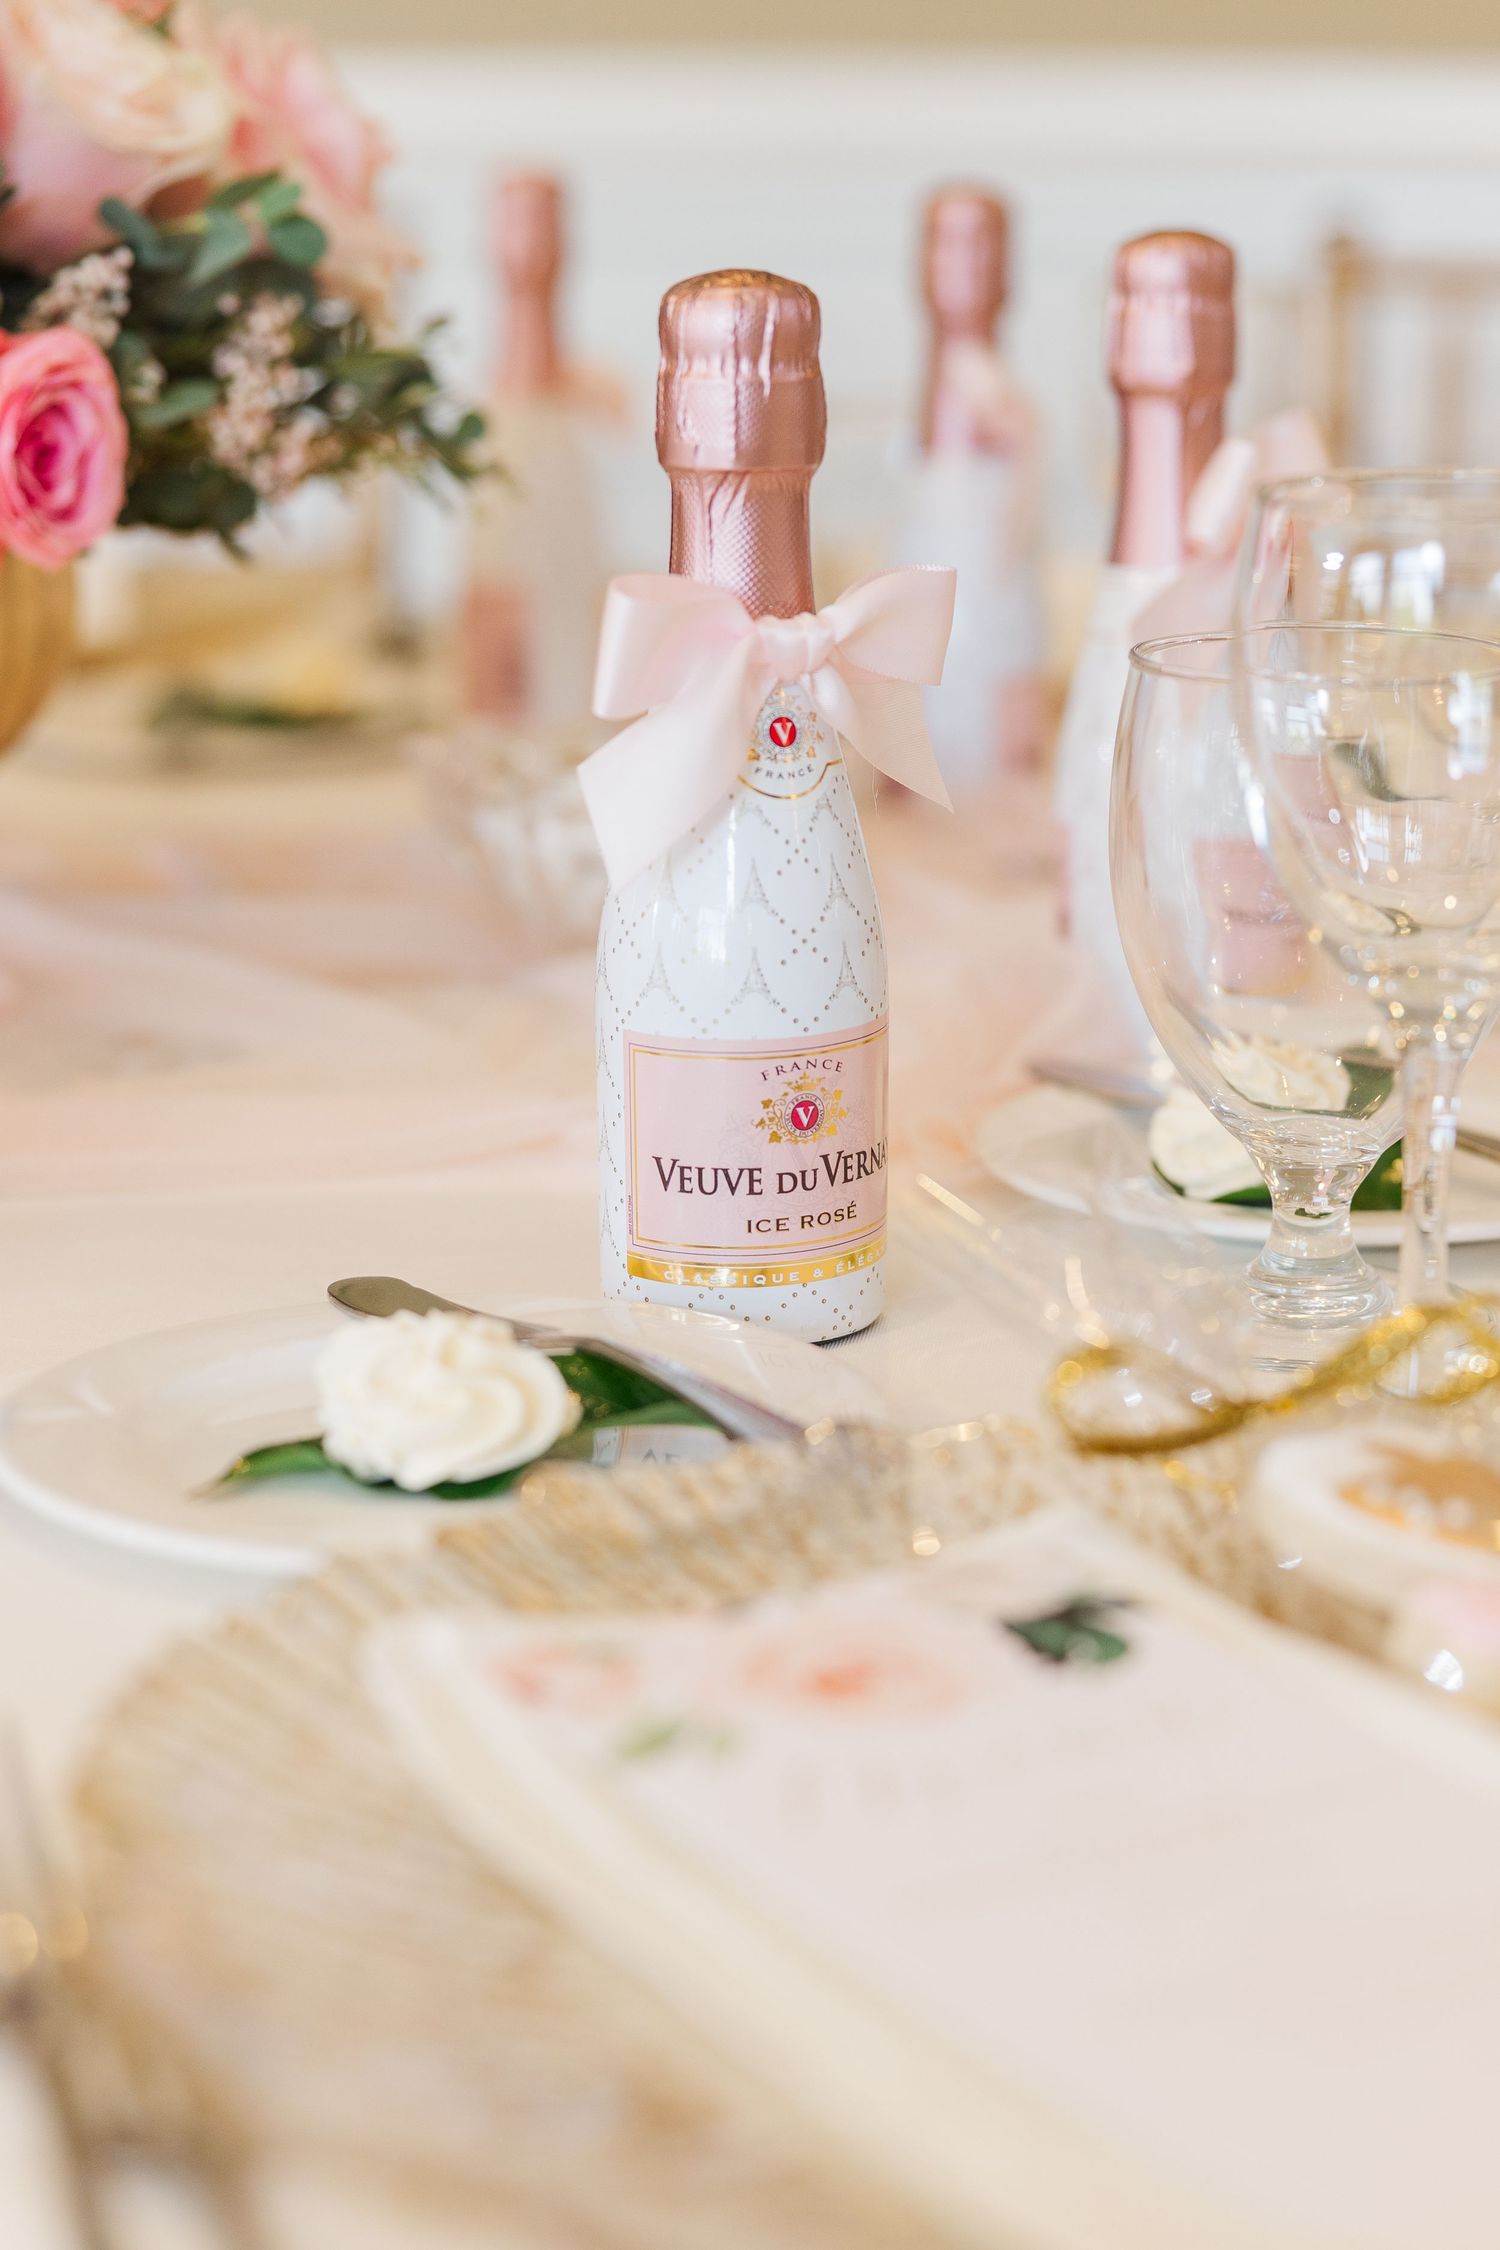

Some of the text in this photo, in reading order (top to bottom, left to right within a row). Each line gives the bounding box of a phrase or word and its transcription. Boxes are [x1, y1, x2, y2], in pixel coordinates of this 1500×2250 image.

[772, 722, 793, 746] V
[754, 764, 814, 779] FRANCE
[760, 1058, 844, 1081] FRANCE
[795, 1105, 815, 1128] V
[652, 1155, 763, 1196] VEUVE
[776, 1167, 819, 1195] DU
[747, 1200, 858, 1233] ICE ROSÉ
[664, 1269, 800, 1286] CLASSIQUE
[812, 1268, 824, 1278] &
